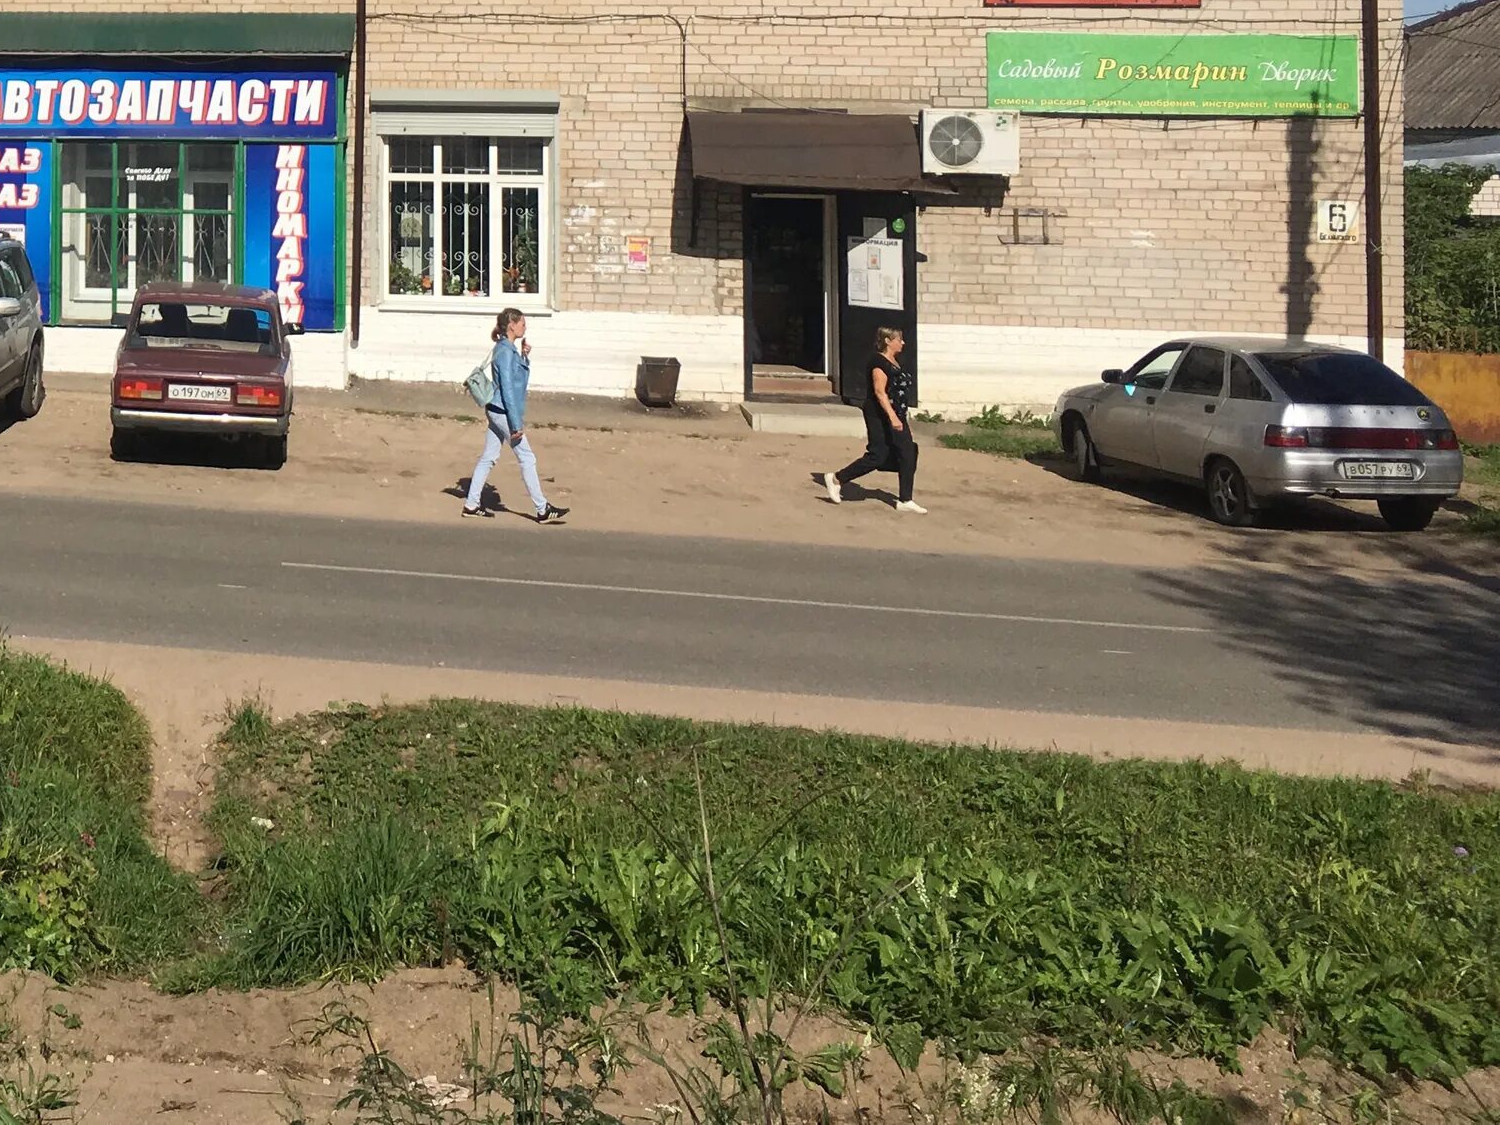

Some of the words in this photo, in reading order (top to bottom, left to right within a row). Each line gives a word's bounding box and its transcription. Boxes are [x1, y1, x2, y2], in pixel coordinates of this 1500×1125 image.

[998, 58, 1086, 82] Садовый
[1095, 57, 1249, 90] Розмарин
[1257, 60, 1338, 91] Дворик
[1328, 203, 1346, 232] 6
[271, 144, 308, 326] ИНОМАРКИ
